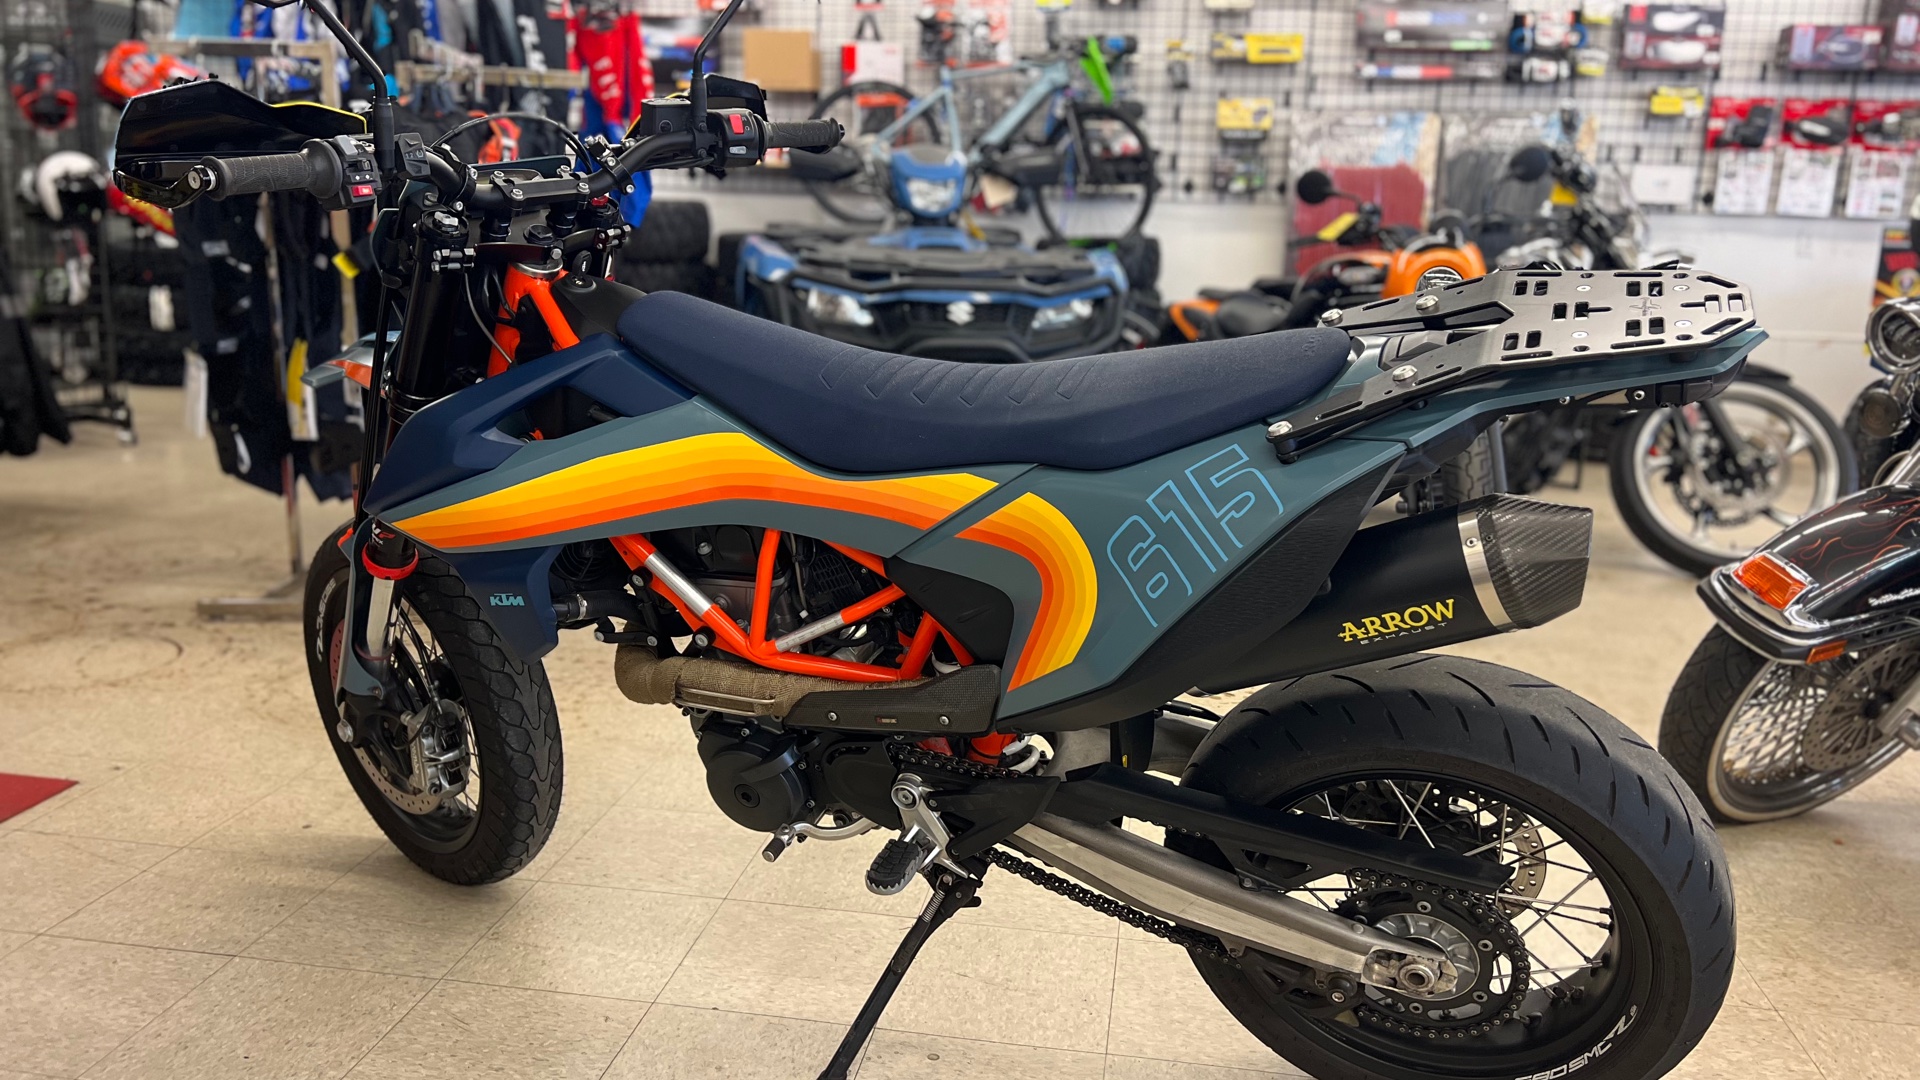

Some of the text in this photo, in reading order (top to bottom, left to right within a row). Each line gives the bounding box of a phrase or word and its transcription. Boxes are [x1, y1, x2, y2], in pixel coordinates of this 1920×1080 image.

[1107, 443, 1284, 628] 615
[490, 593, 525, 606] KTM
[1338, 599, 1454, 642] ARROW
[1360, 622, 1447, 645] EXHAUST
